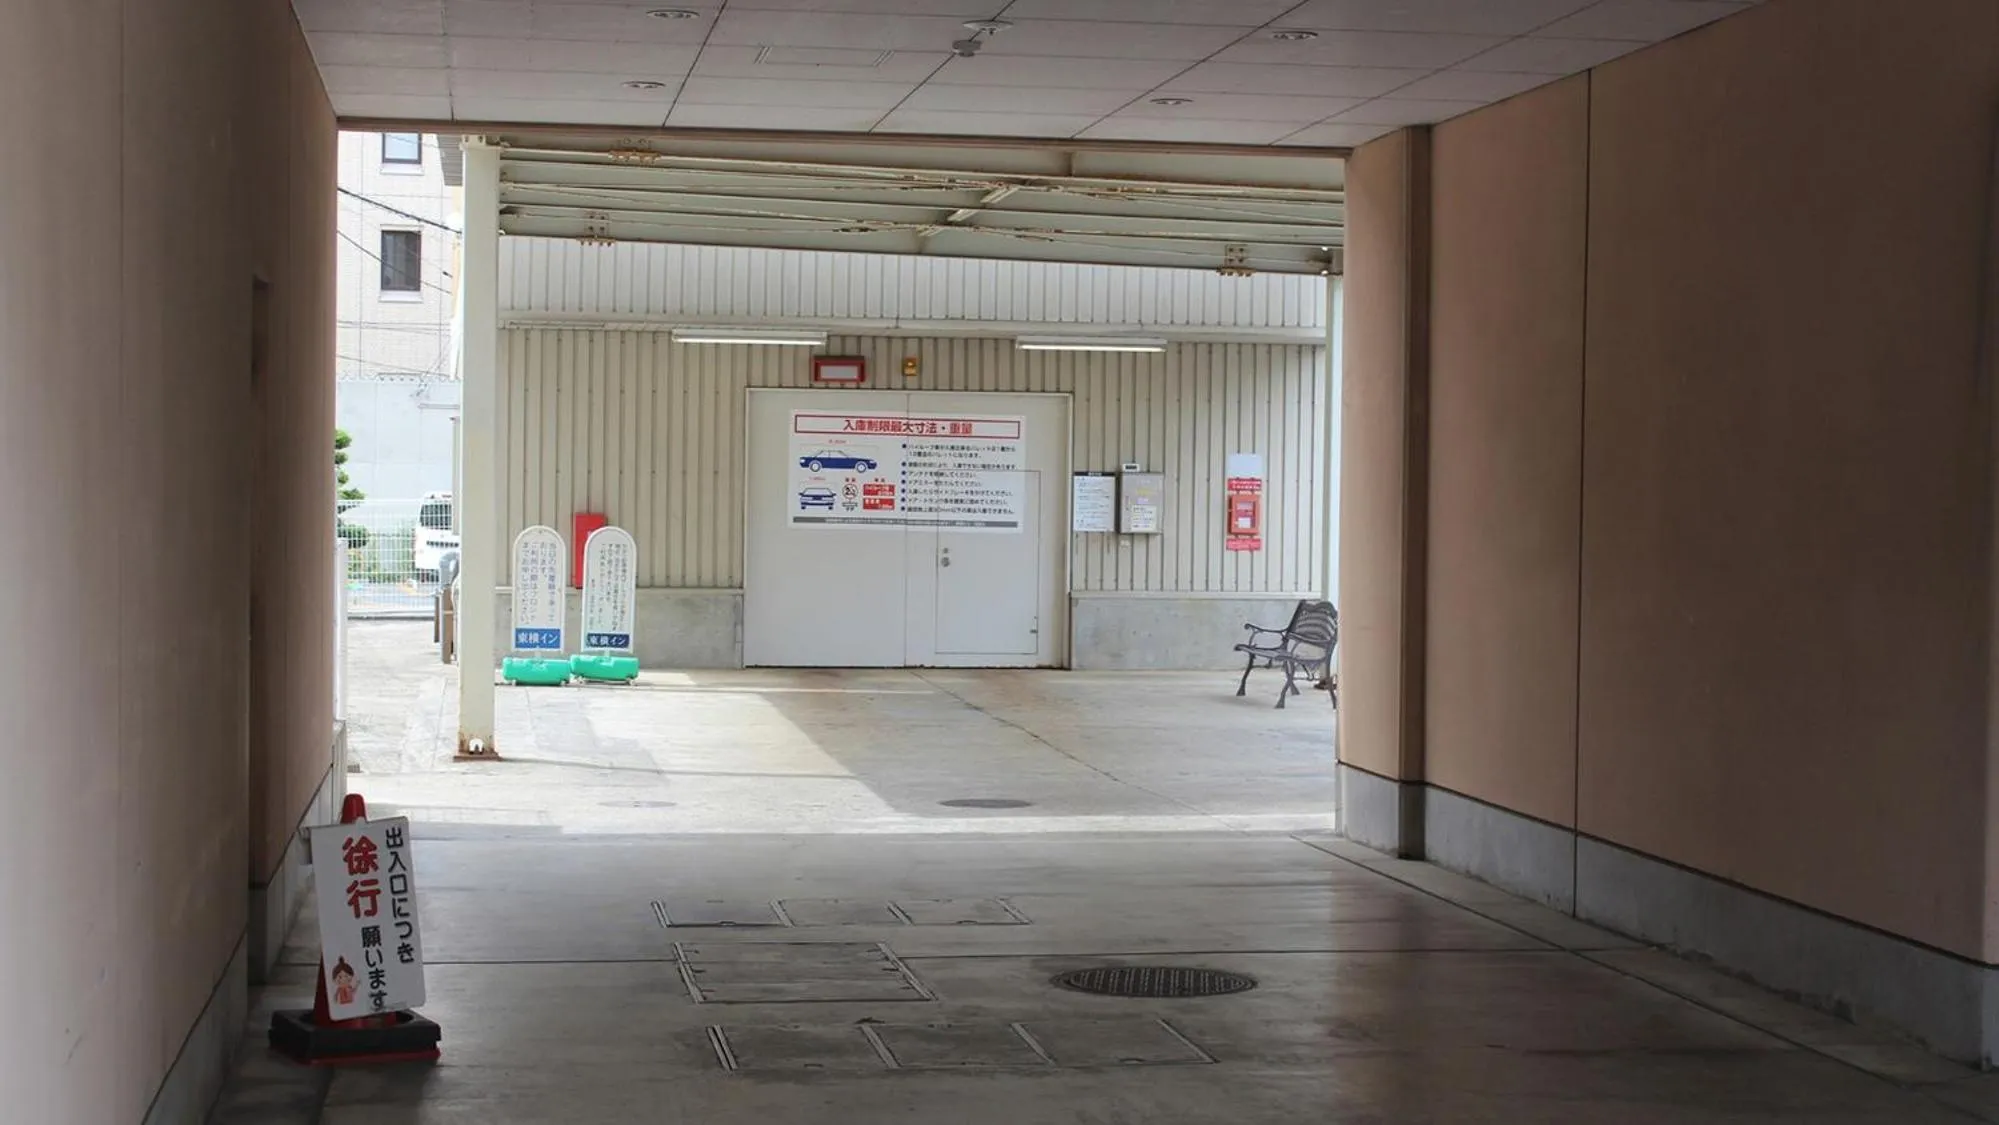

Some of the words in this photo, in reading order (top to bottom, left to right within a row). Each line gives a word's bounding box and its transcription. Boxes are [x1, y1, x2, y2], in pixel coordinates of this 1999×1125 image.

[843, 419, 973, 435] 入庫制限最大寸法・重量
[517, 633, 558, 645] 東横イン
[590, 636, 625, 645] 東横イン
[342, 835, 382, 919] 徐行
[385, 827, 414, 964] 出入口につき
[361, 925, 388, 1012] 願います
